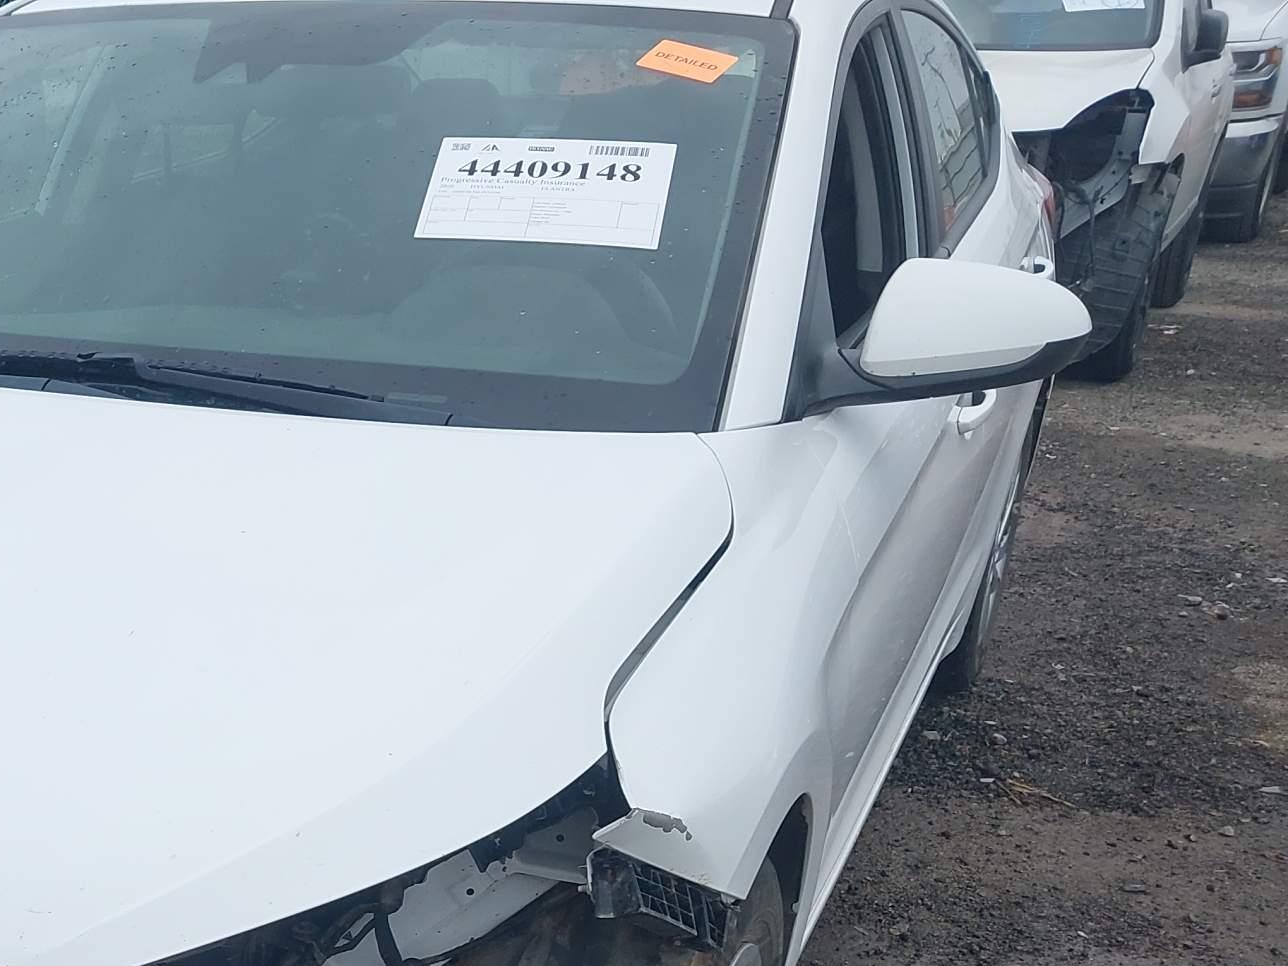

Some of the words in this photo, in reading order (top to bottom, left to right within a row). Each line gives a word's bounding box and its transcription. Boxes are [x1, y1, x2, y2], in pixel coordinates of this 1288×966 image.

[654, 51, 718, 71] DETAILED
[458, 159, 642, 182] 44409148
[440, 176, 495, 185] Progressive
[496, 177, 537, 186] Casualty
[540, 179, 586, 187] Insurance
